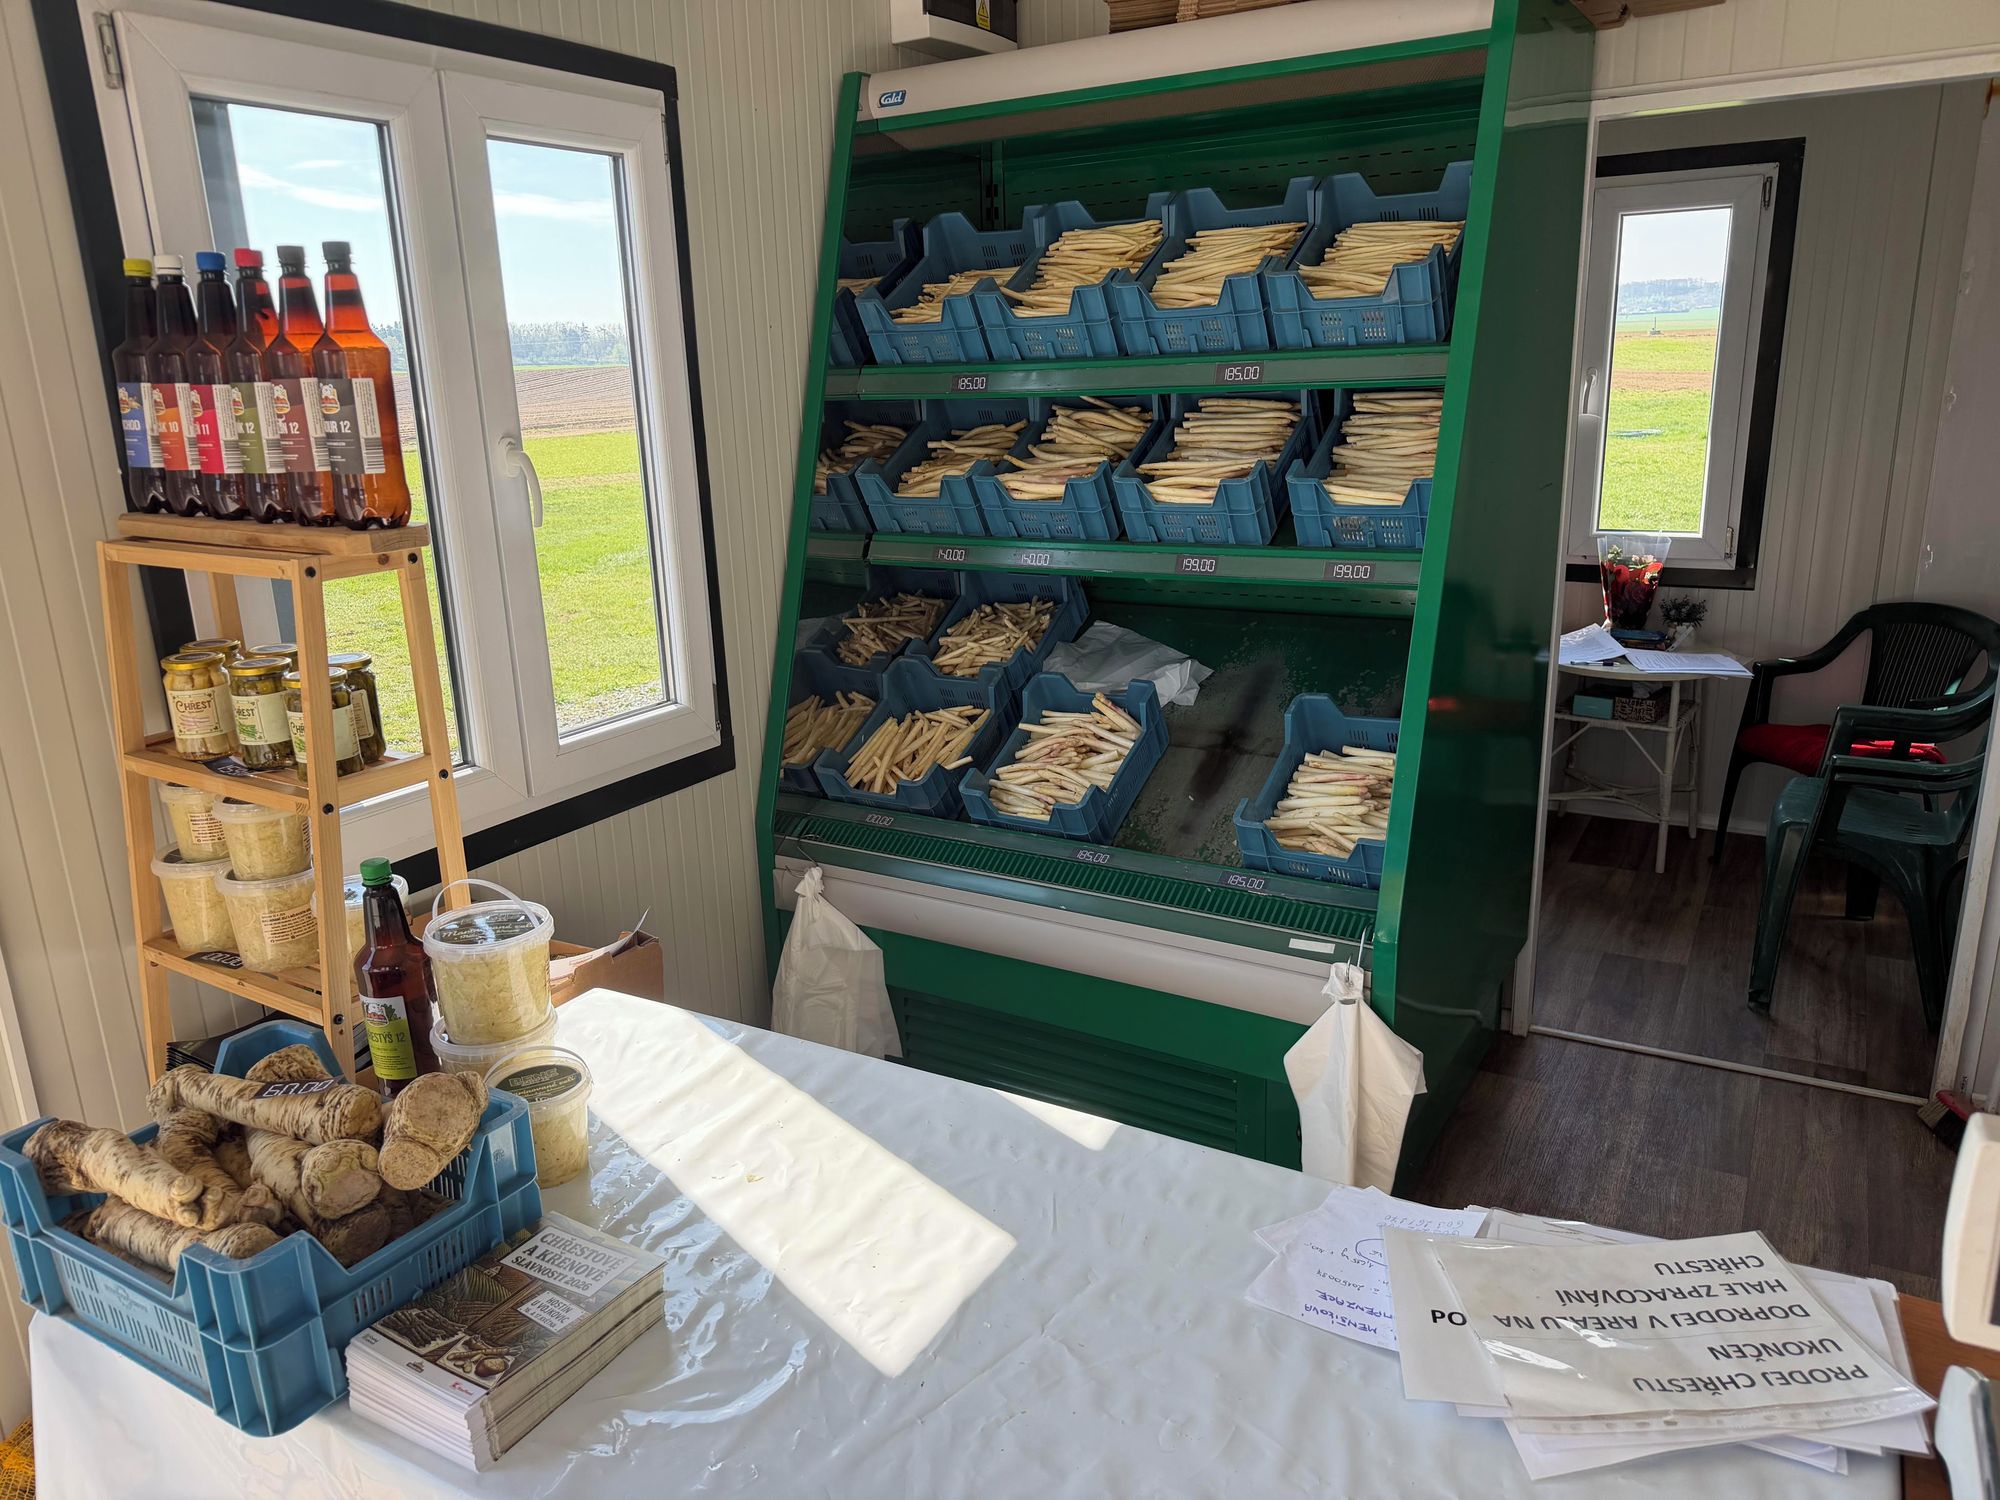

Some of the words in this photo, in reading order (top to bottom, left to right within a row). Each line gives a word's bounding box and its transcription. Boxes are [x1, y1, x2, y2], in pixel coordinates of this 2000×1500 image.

[340, 420, 352, 433] 12
[396, 1031, 405, 1042] 12
[540, 1232, 627, 1270] CHŘESTOVÉ
[511, 1255, 566, 1284] SLAVNOSTI
[563, 1278, 593, 1292] 2026
[522, 1244, 539, 1256] A
[535, 1248, 608, 1282] KŘENOVÉ
[1654, 1255, 1765, 1275] CHŘESTU
[1555, 1284, 1719, 1307] ZPRACOVÁNÍ
[1719, 1278, 1788, 1296] HALE
[1493, 1314, 1535, 1330] NA
[1648, 1315, 1669, 1329] V
[1670, 1304, 1811, 1327] DOPRODEJ
[1707, 1338, 1843, 1362] UKONČEN
[1632, 1372, 1757, 1396] CHŘESTU
[1761, 1364, 1869, 1387] PRODEJ
